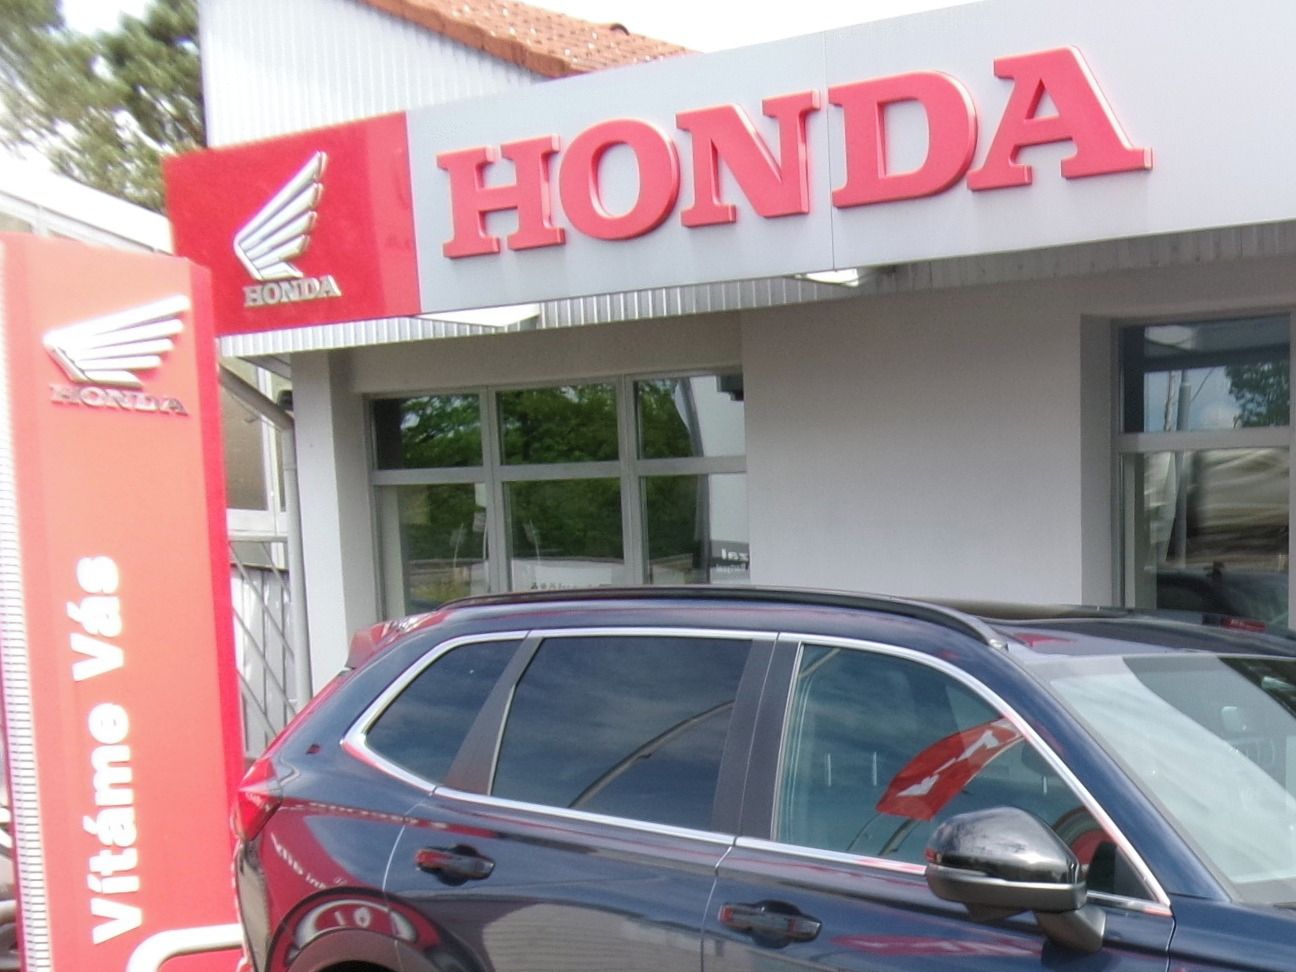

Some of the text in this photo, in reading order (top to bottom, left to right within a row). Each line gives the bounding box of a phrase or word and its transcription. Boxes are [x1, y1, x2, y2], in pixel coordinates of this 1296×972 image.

[437, 45, 1153, 259] HONDA
[243, 274, 342, 308] HONDA
[49, 383, 188, 417] HONDA
[67, 555, 142, 945] Vítáme Vás
